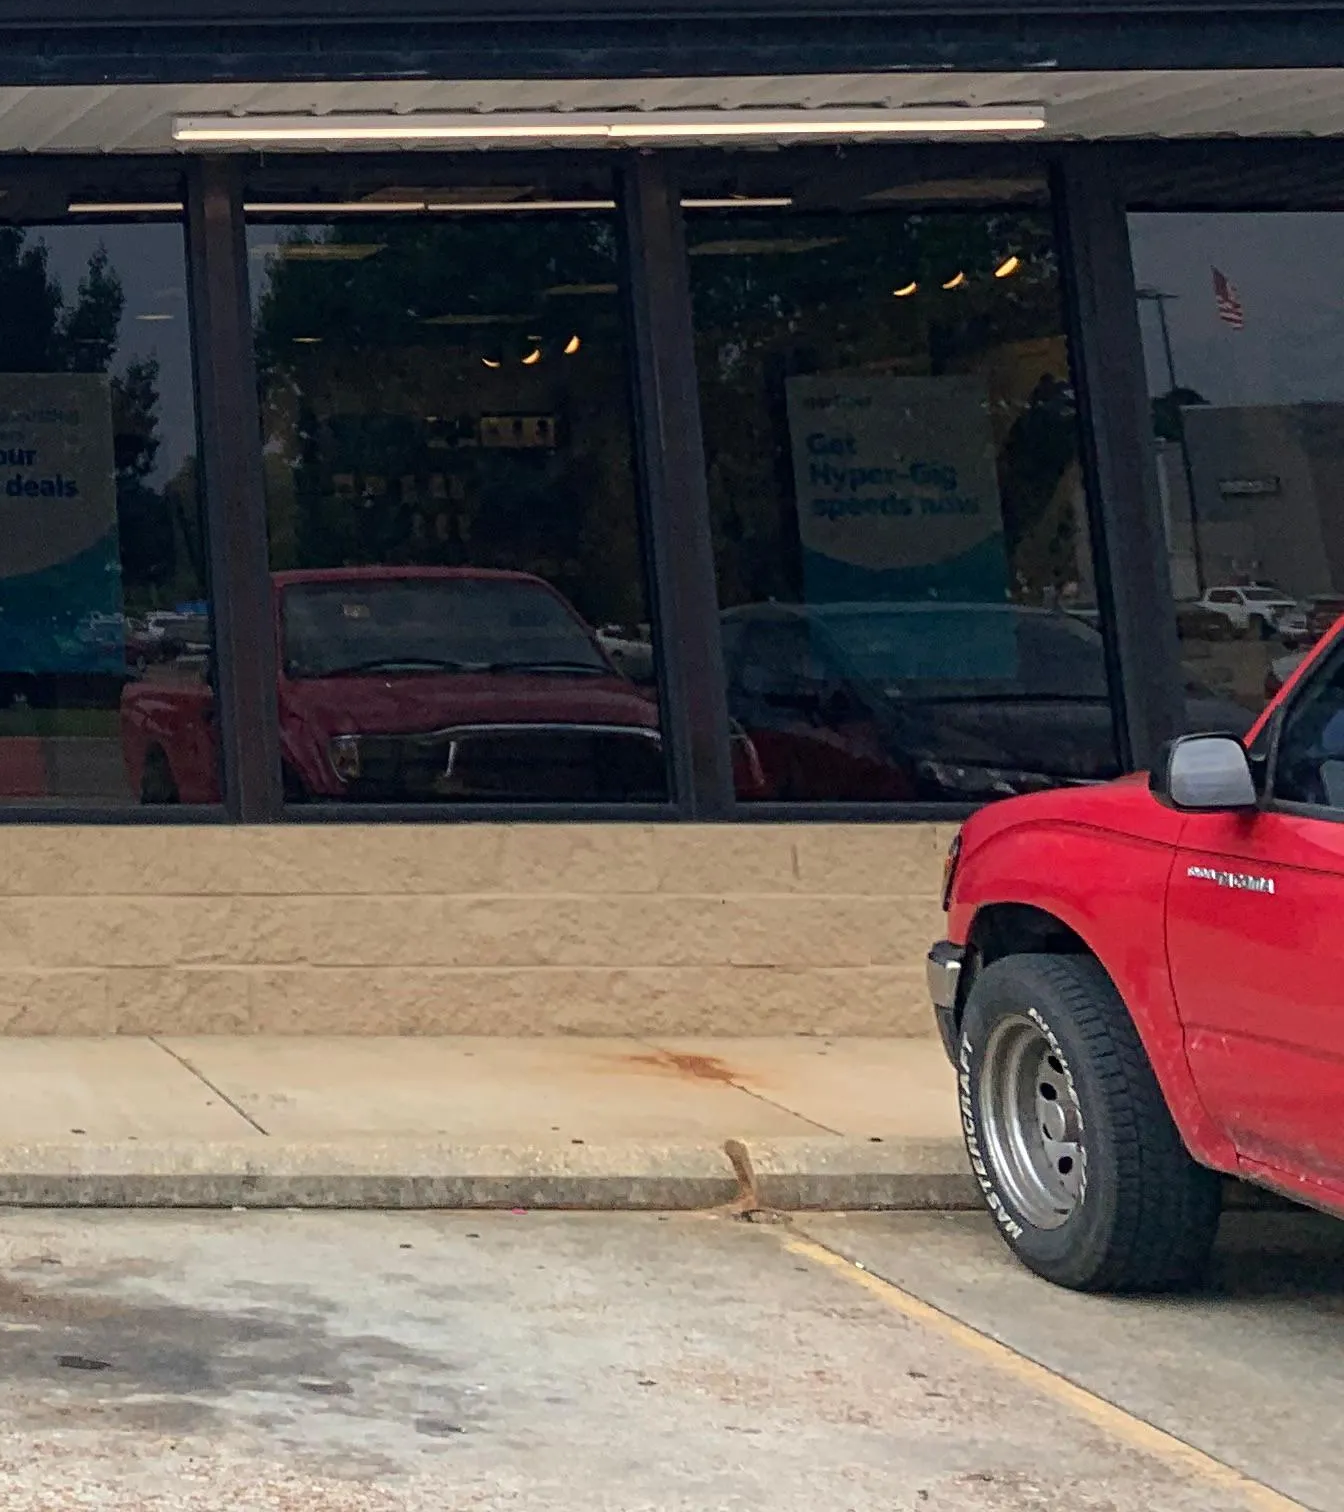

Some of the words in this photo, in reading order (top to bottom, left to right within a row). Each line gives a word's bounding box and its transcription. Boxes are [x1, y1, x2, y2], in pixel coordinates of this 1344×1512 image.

[806, 432, 857, 455] Get
[6, 473, 78, 496] deals
[960, 1031, 1024, 1239] MASTERCRAFT
